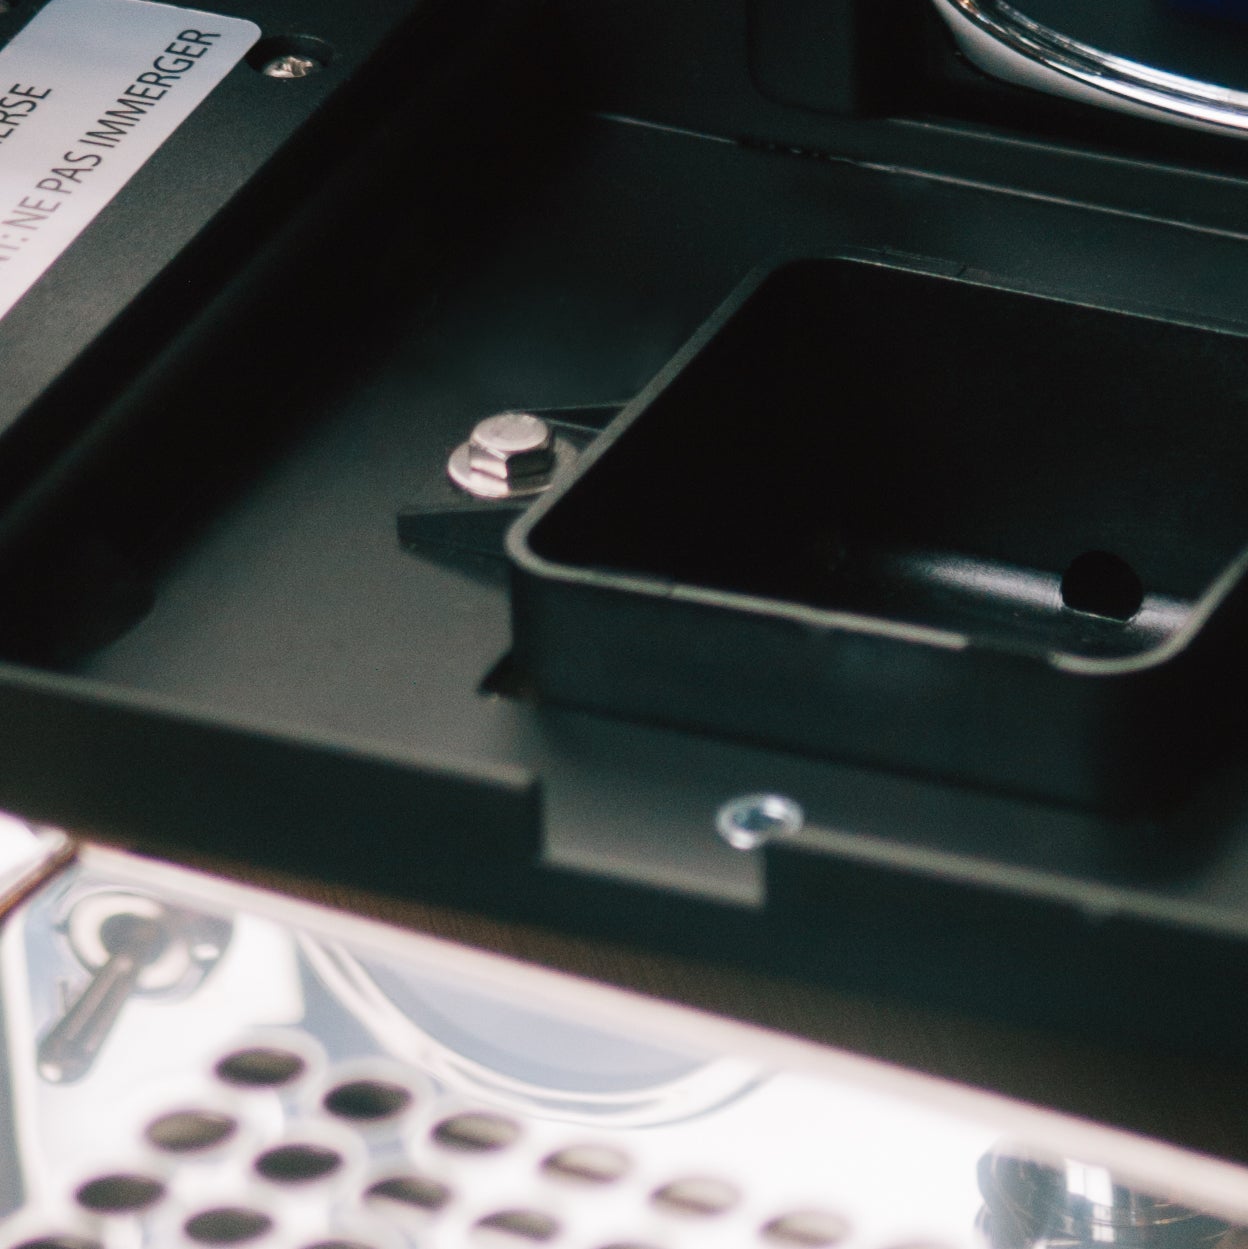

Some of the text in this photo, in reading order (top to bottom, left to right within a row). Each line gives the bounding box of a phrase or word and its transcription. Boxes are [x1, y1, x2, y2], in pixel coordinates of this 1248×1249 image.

[1, 196, 62, 230] NE
[35, 150, 102, 194] PAS
[77, 27, 222, 148] IMMERGER
